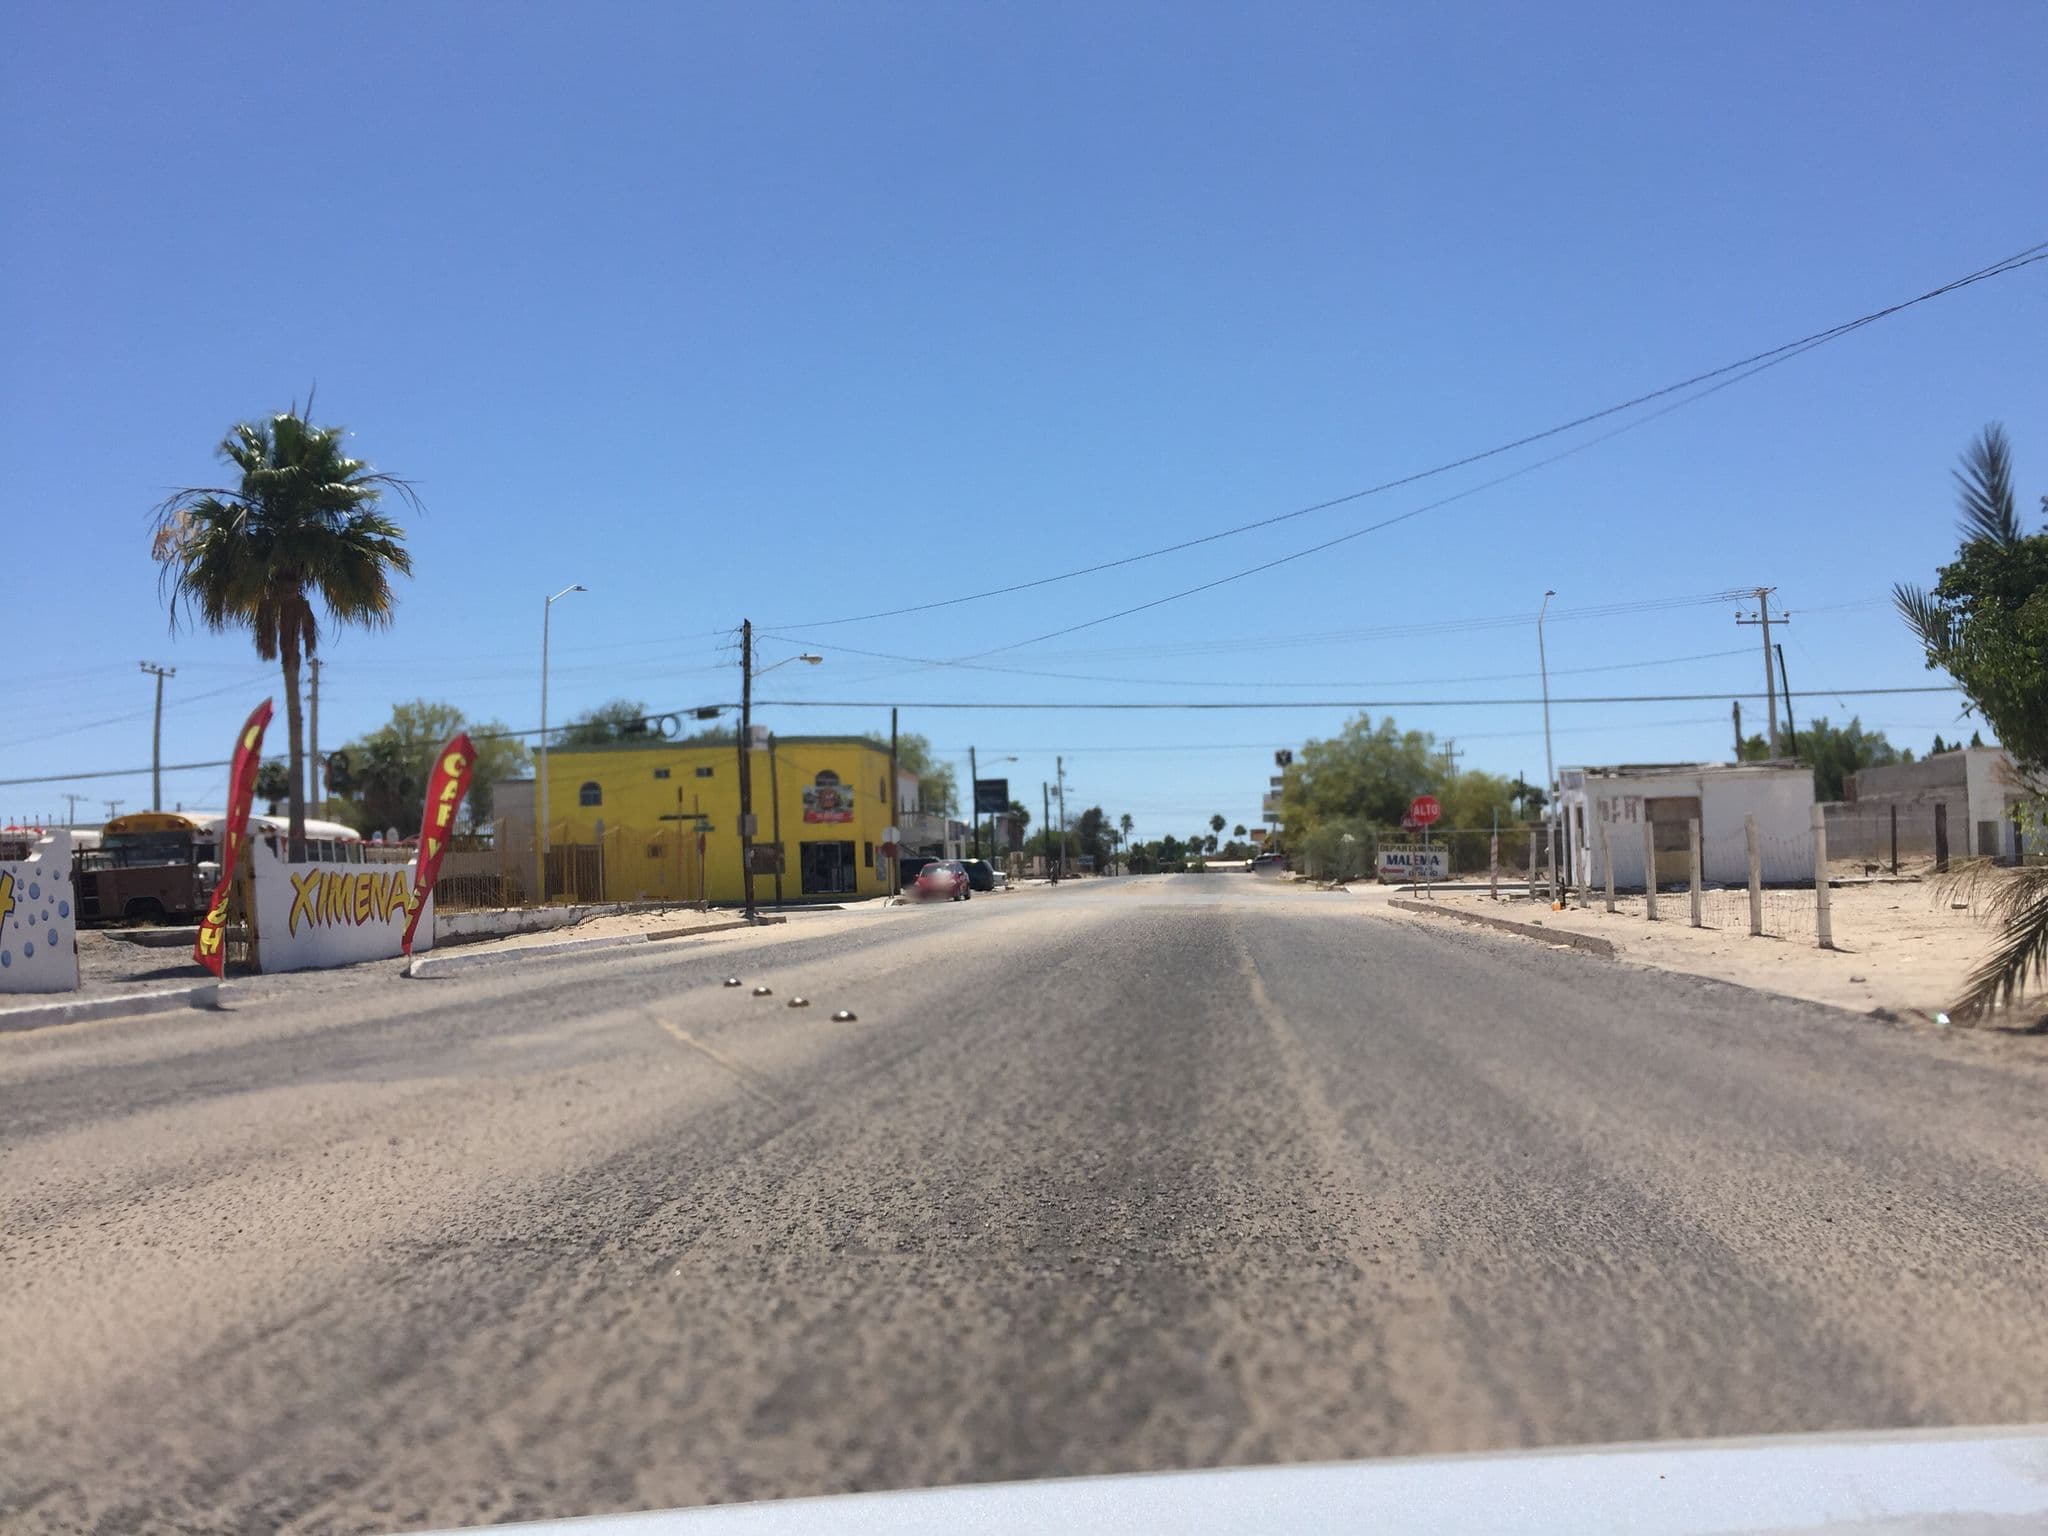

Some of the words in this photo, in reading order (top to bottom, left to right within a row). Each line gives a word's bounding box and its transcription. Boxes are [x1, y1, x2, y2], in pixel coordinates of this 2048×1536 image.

[1413, 804, 1438, 816] ALTO
[1386, 855, 1440, 865] MALENA
[289, 868, 412, 939] XIMENA
